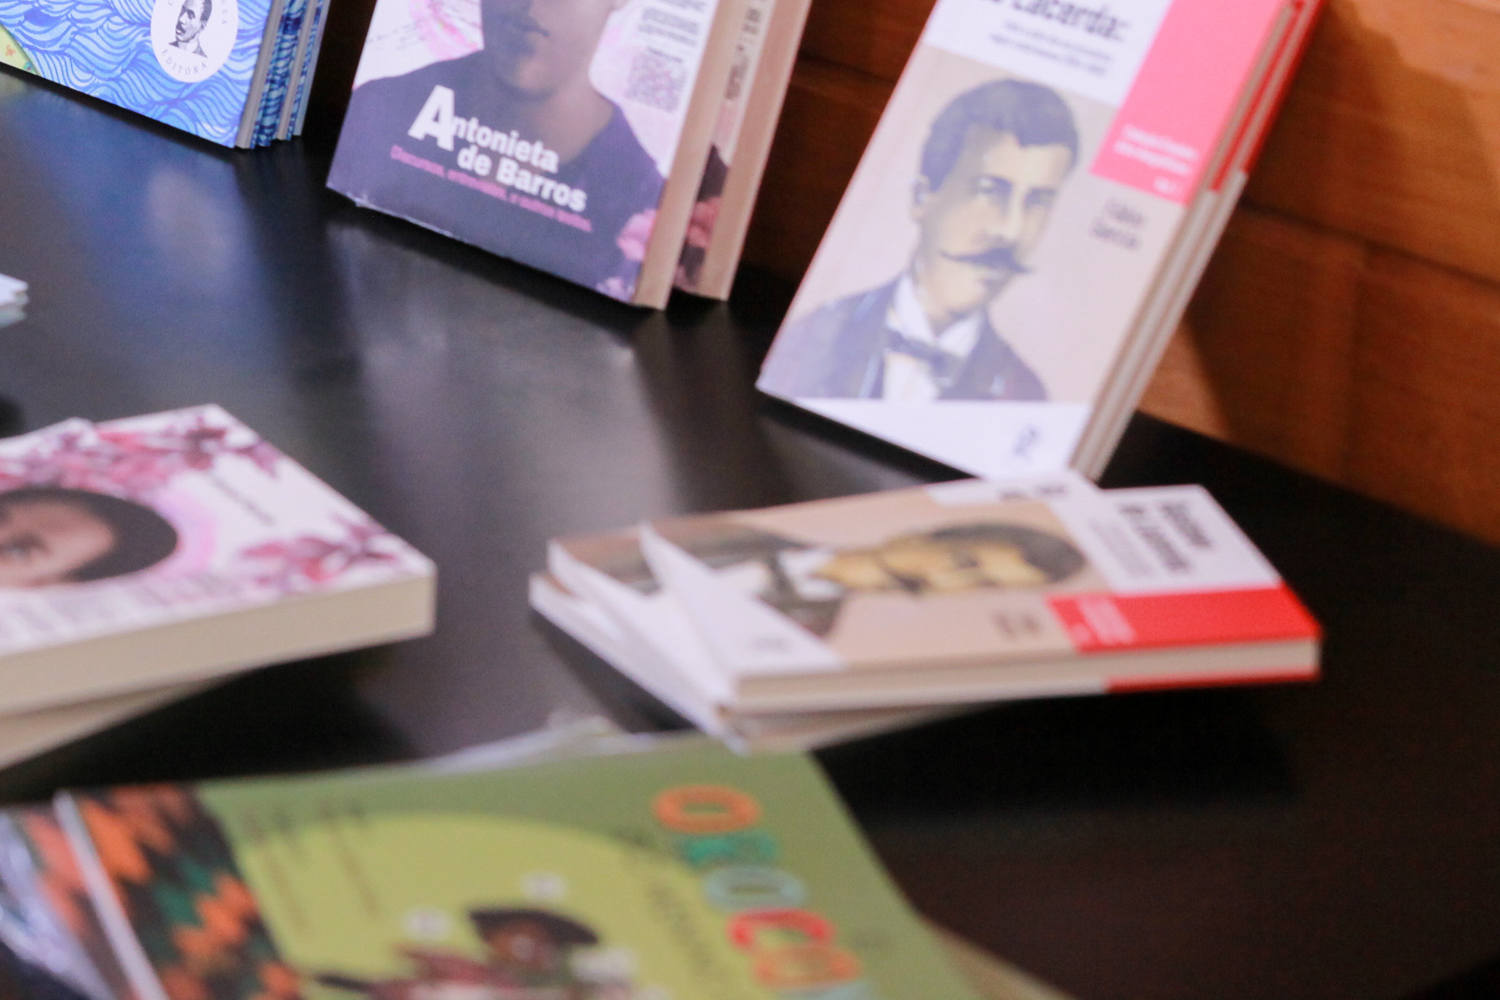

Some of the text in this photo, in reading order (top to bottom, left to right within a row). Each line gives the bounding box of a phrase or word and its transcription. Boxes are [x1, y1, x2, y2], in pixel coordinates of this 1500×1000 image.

[162, 48, 207, 76] EDITORA
[407, 84, 560, 175] Antonieta
[457, 144, 492, 177] de
[496, 156, 588, 212] Barros
